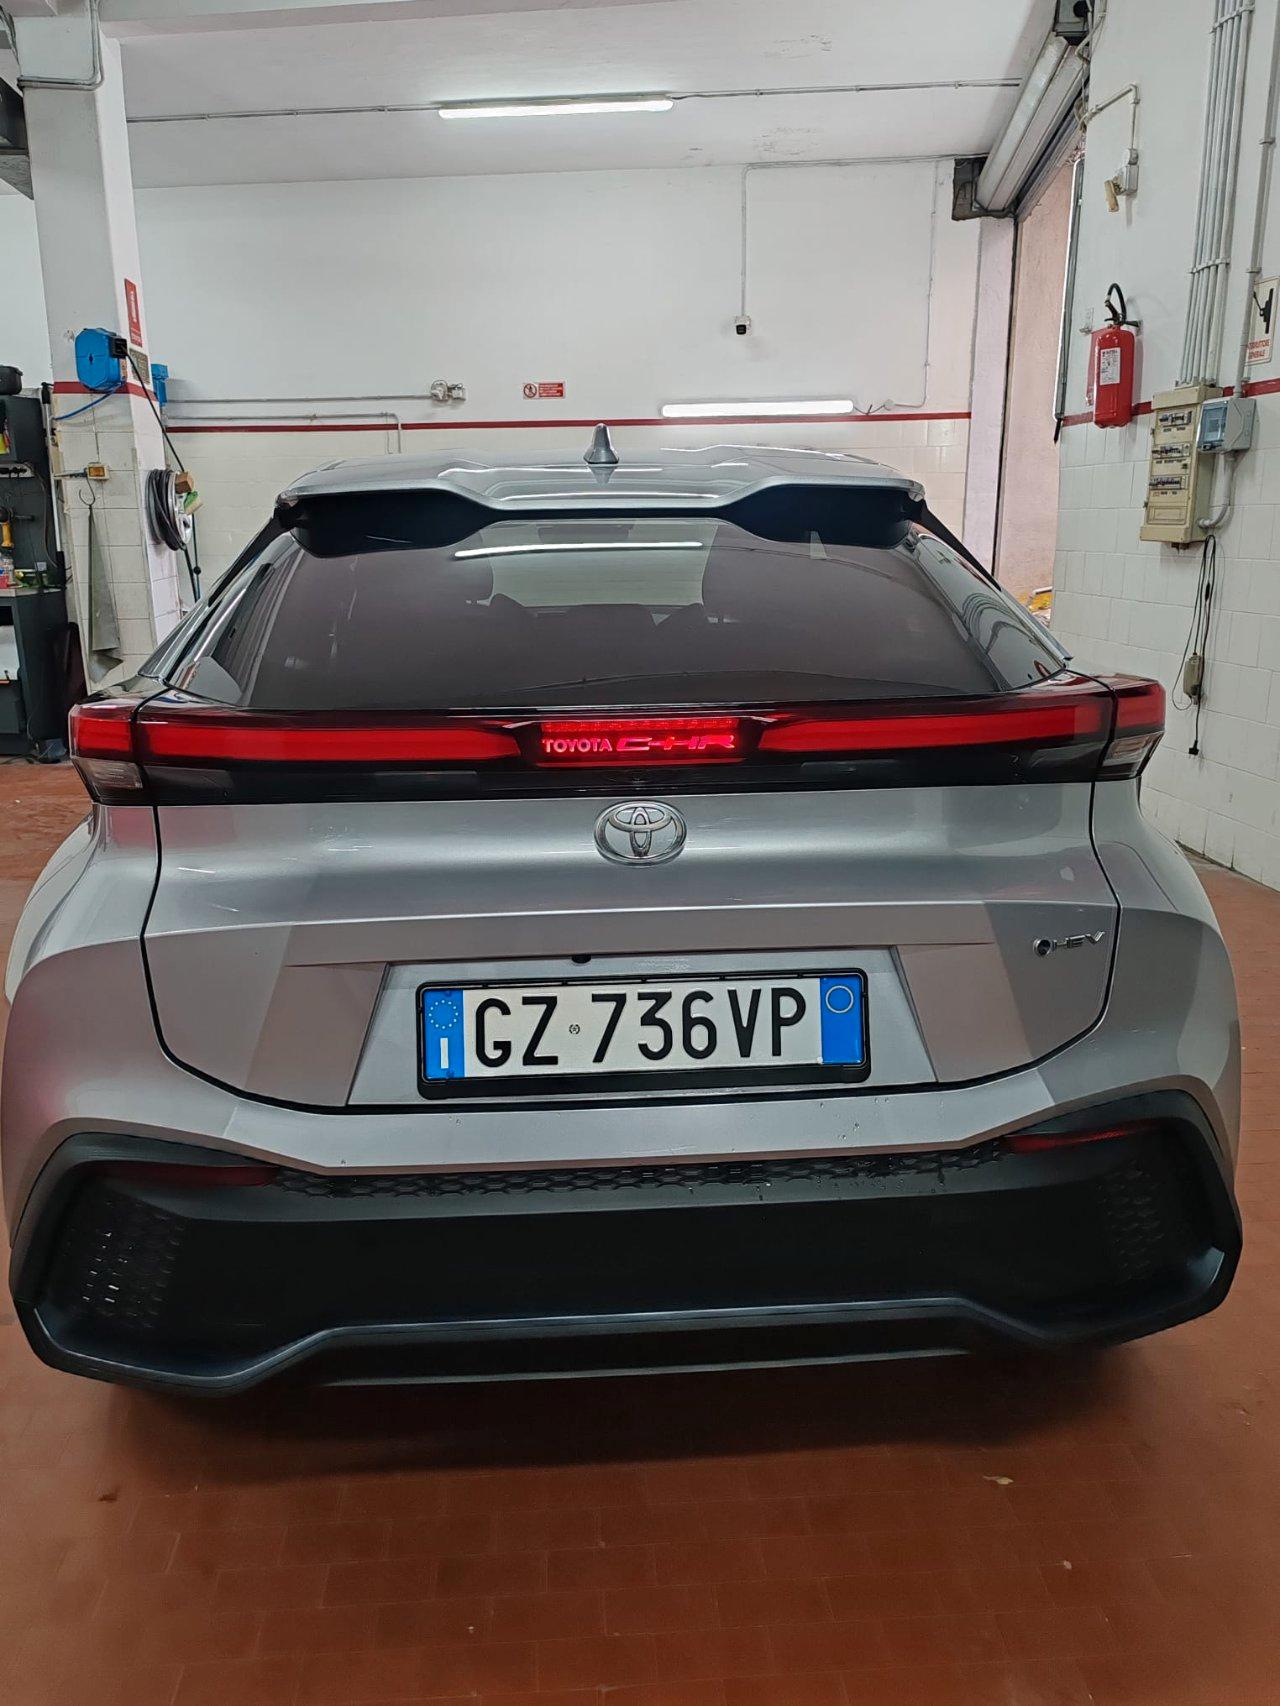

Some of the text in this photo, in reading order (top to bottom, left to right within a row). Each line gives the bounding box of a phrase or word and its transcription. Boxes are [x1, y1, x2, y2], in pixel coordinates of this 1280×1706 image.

[542, 738, 613, 753] TOYOTA
[475, 987, 807, 1068] GZ 736VP
